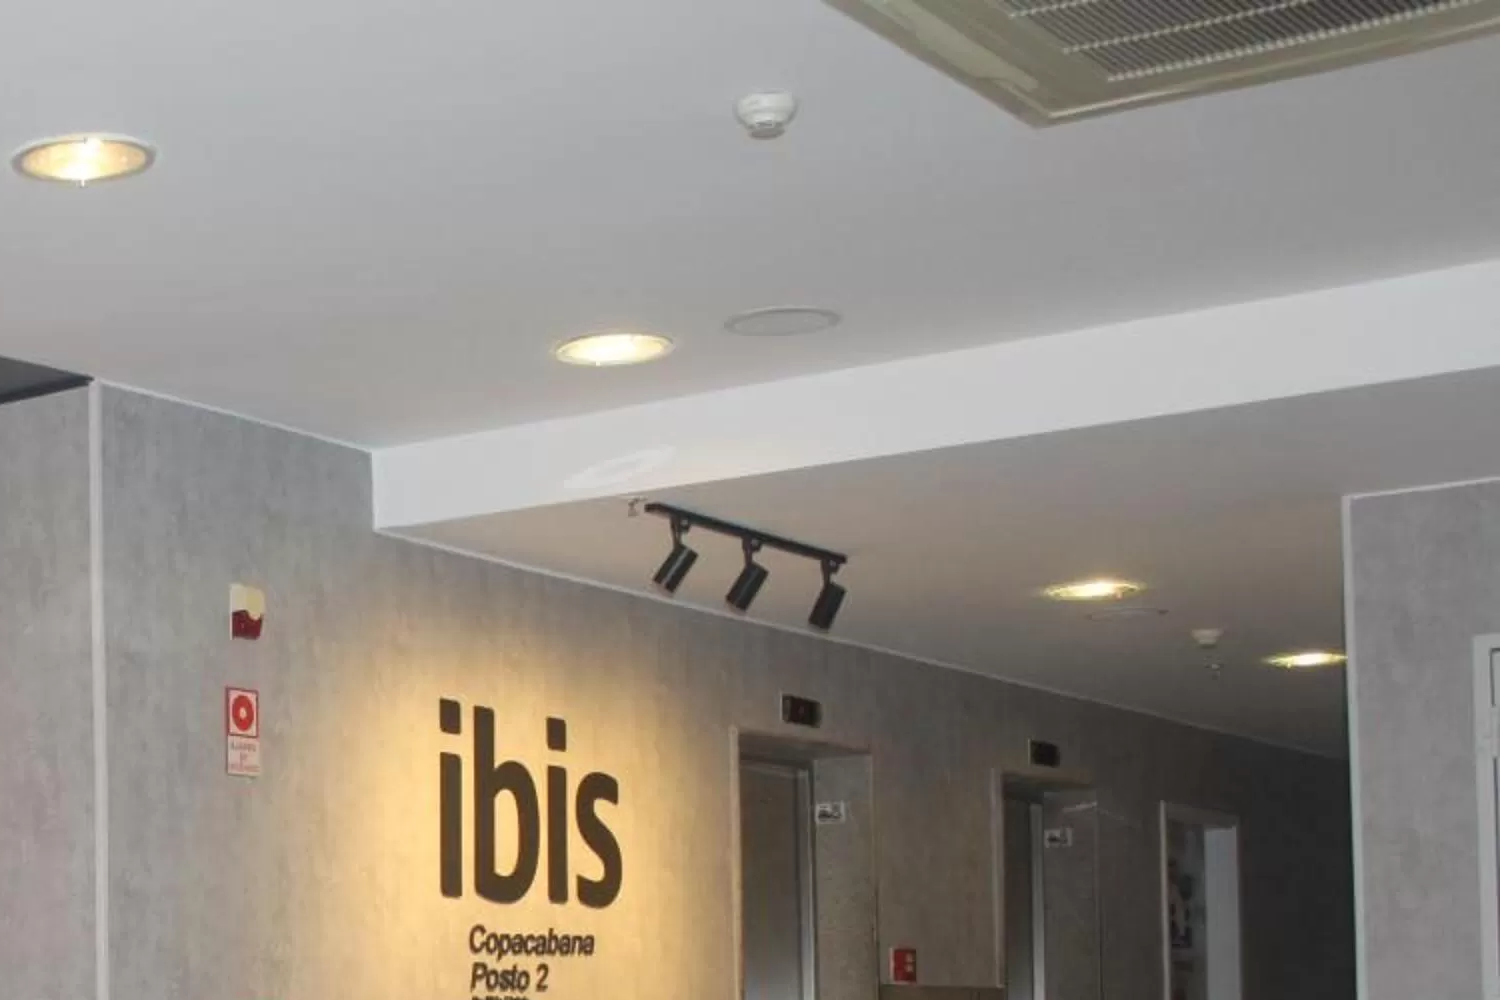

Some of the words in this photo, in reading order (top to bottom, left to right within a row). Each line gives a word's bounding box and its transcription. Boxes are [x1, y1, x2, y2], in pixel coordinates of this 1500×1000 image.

[439, 697, 623, 909] ibis
[469, 923, 595, 961] Copacabana
[470, 961, 530, 993] Posto
[535, 962, 549, 992] 2
